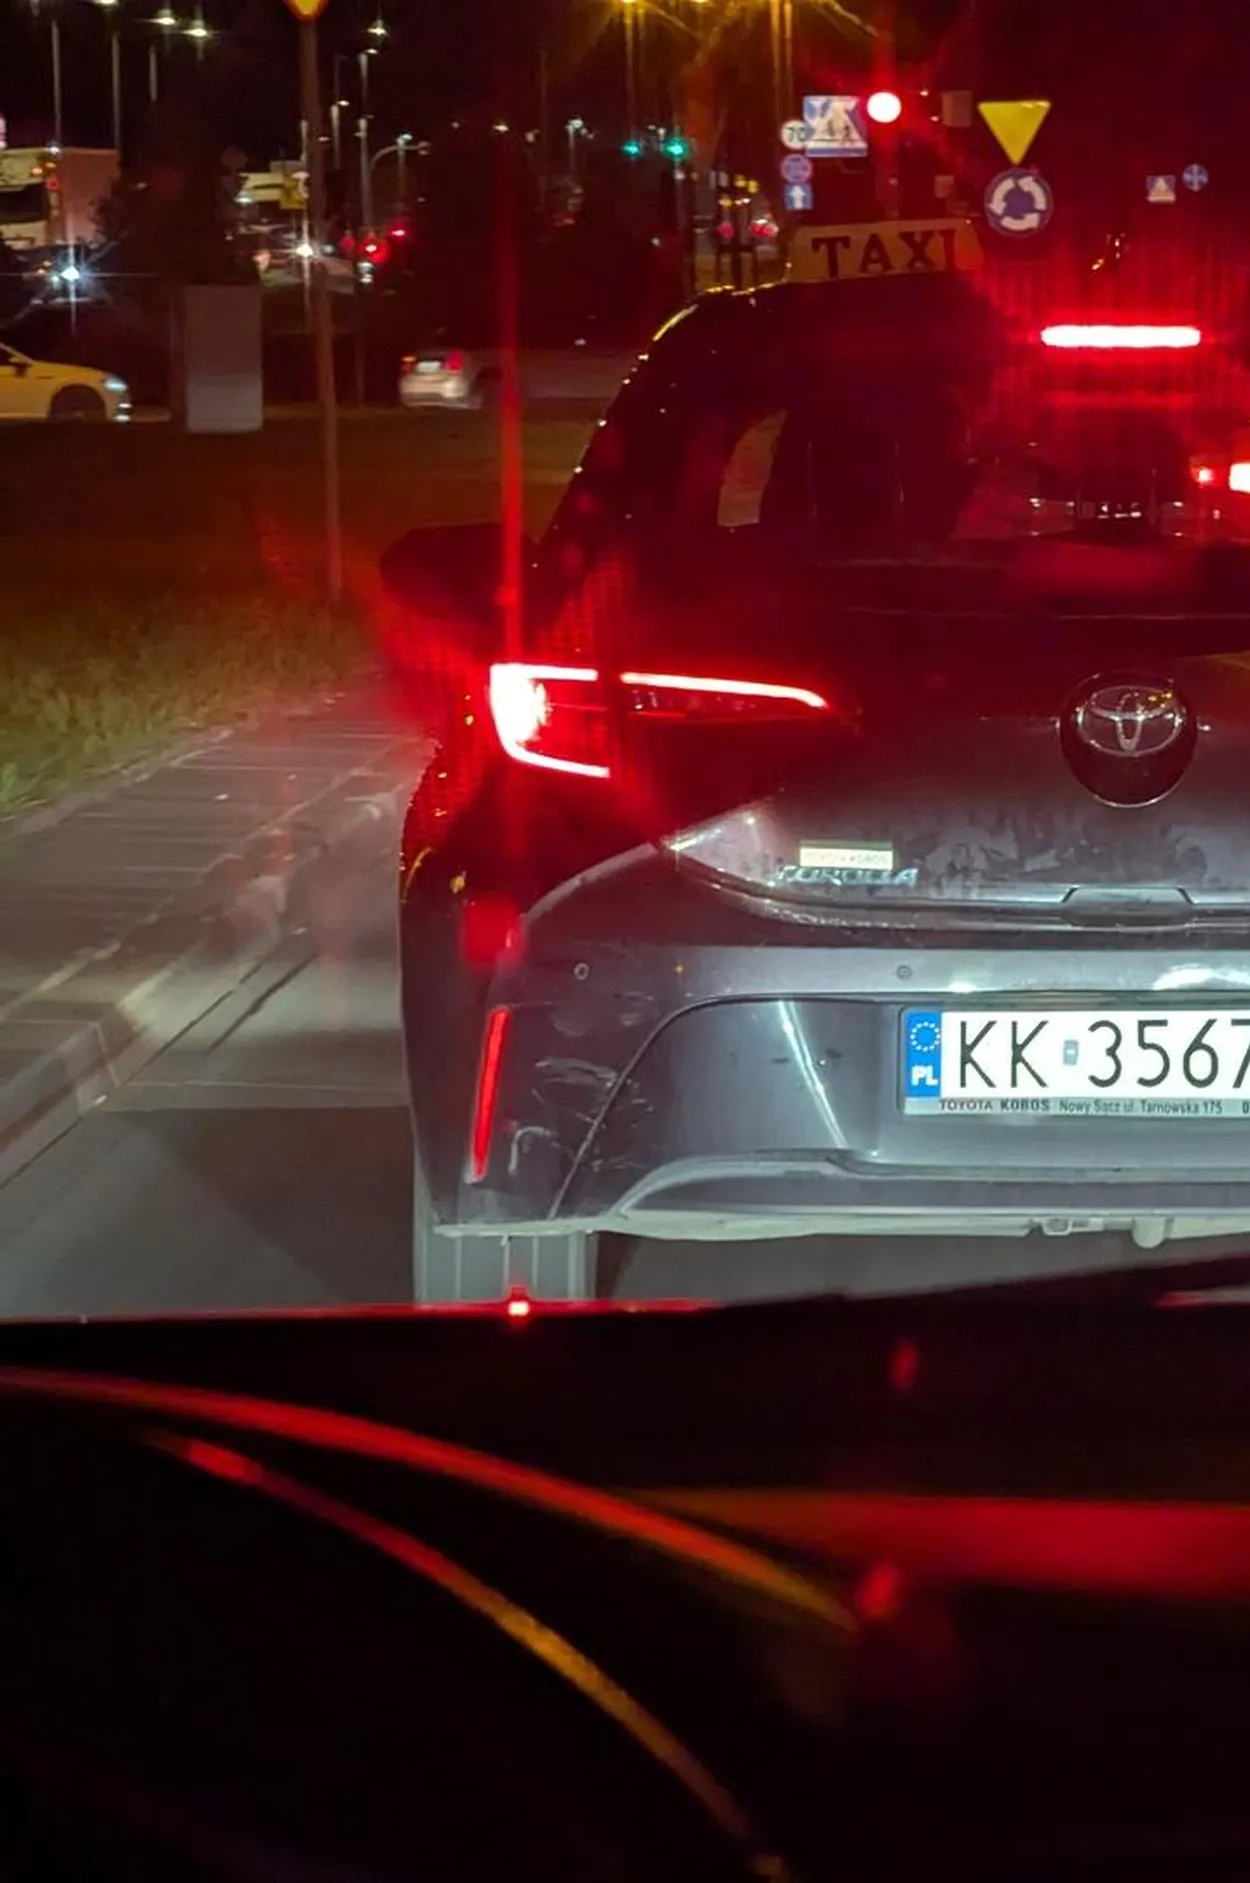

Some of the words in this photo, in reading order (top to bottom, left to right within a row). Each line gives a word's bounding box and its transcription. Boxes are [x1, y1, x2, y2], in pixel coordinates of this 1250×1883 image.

[811, 227, 956, 279] TAXI
[960, 1019, 1049, 1089] KK
[911, 1065, 938, 1086] PL
[939, 1099, 993, 1111] TOYOTA
[1059, 1099, 1090, 1113] Nowy
[1203, 1101, 1223, 1114] 175
